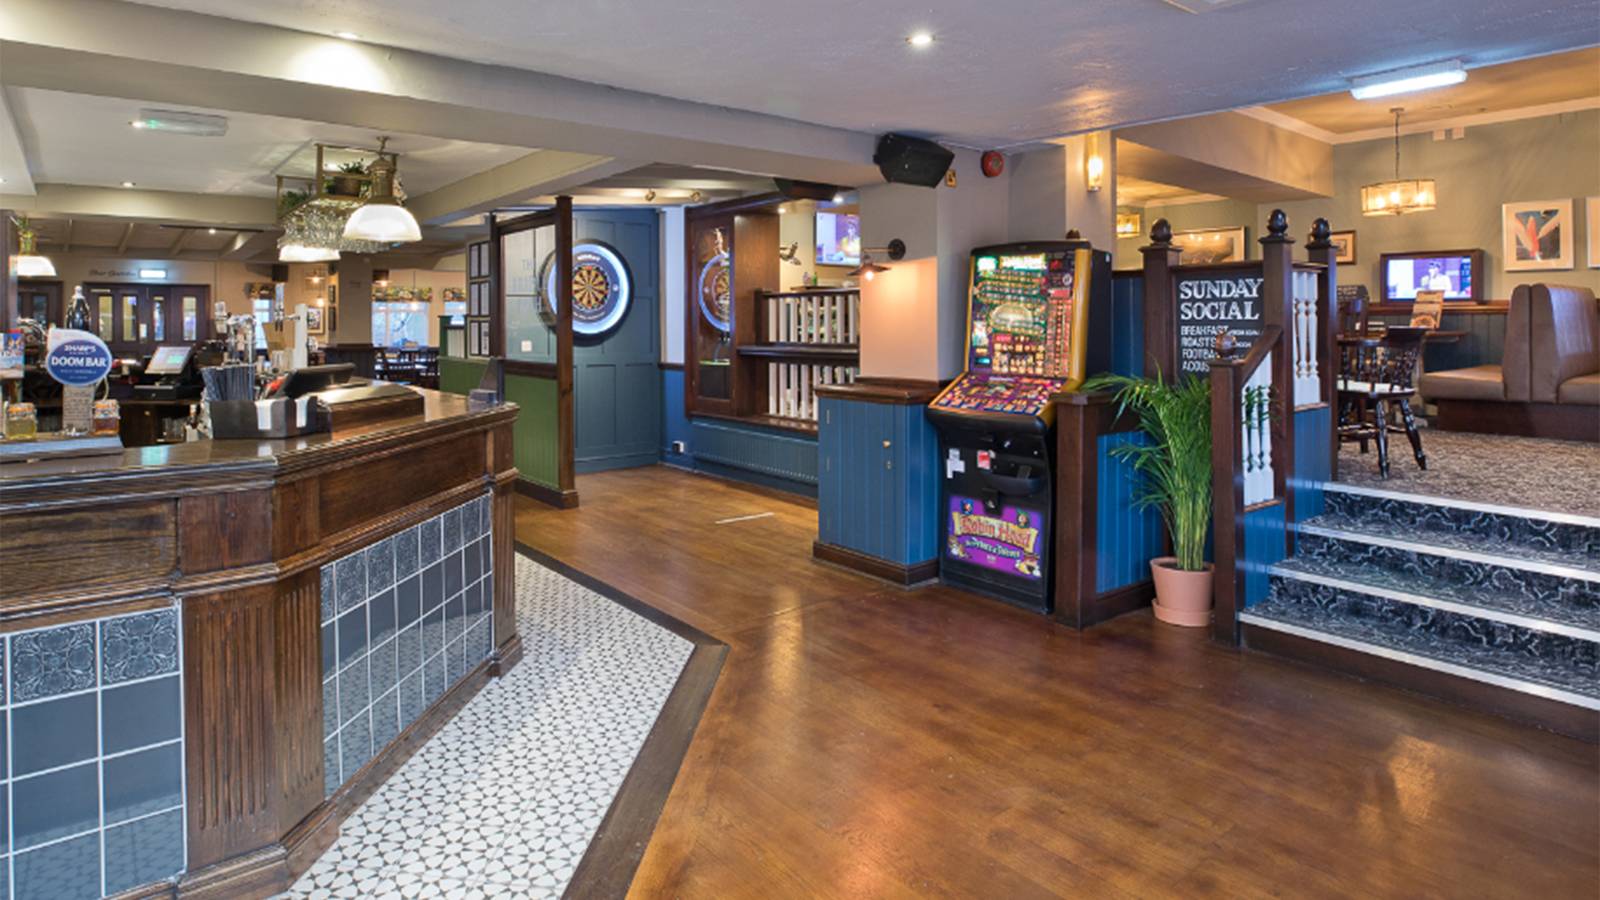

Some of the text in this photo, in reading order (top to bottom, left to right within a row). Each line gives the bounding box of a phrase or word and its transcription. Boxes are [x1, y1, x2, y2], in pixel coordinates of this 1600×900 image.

[1179, 278, 1264, 299] SUNDAY
[1180, 301, 1260, 320] SOCIAL
[51, 356, 107, 367] DOOM BAR
